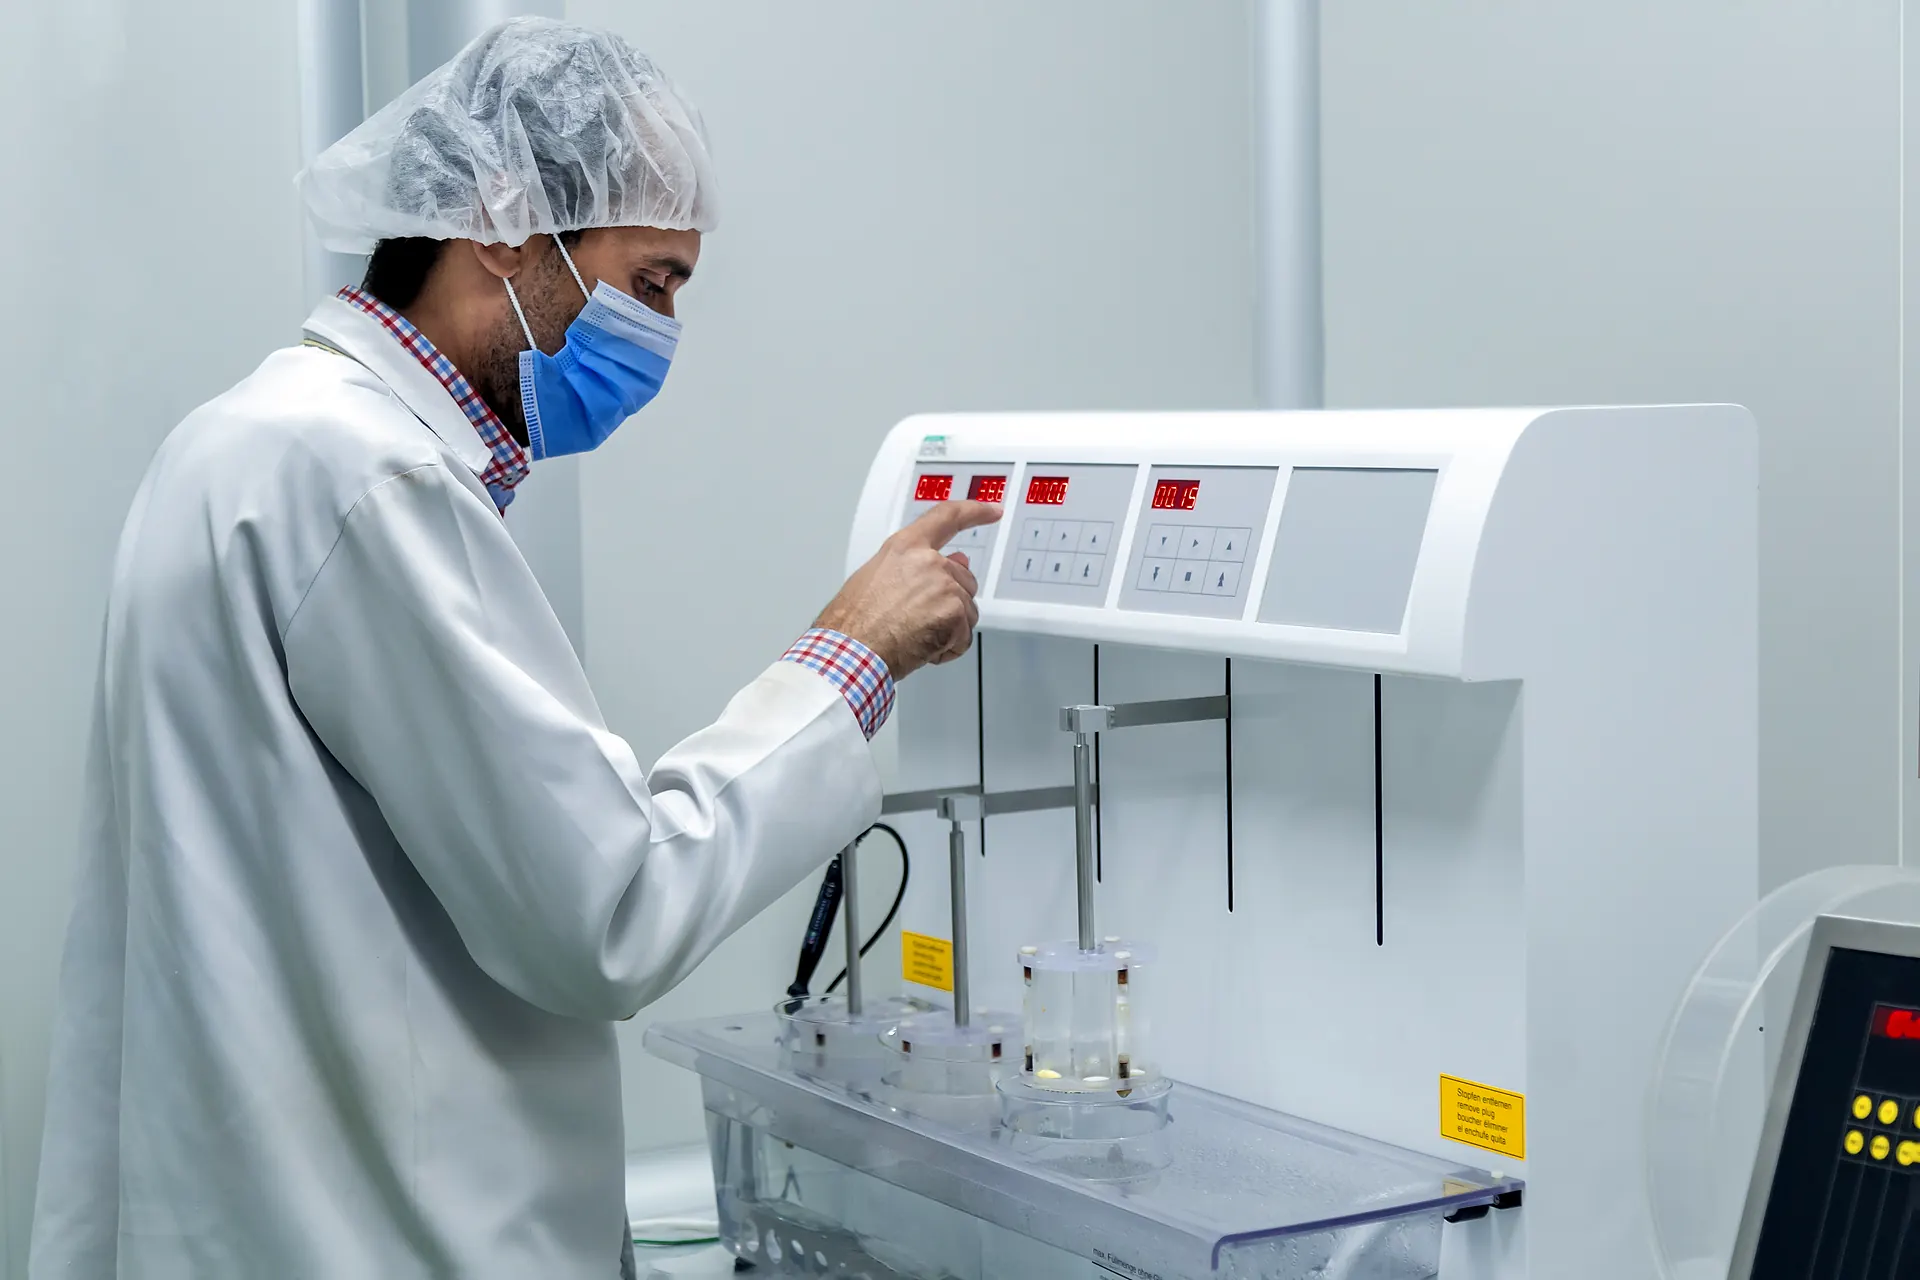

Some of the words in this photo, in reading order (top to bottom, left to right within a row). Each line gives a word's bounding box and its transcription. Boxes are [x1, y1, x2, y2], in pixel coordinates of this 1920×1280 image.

[1457, 1088, 1481, 1101] Stopfen
[1482, 1097, 1512, 1110] entfernen
[1457, 1101, 1480, 1114] remove
[1482, 1108, 1495, 1120] plug
[1457, 1113, 1482, 1126] boucher
[1464, 1127, 1489, 1140] enchufe
[1490, 1134, 1506, 1145] quita
